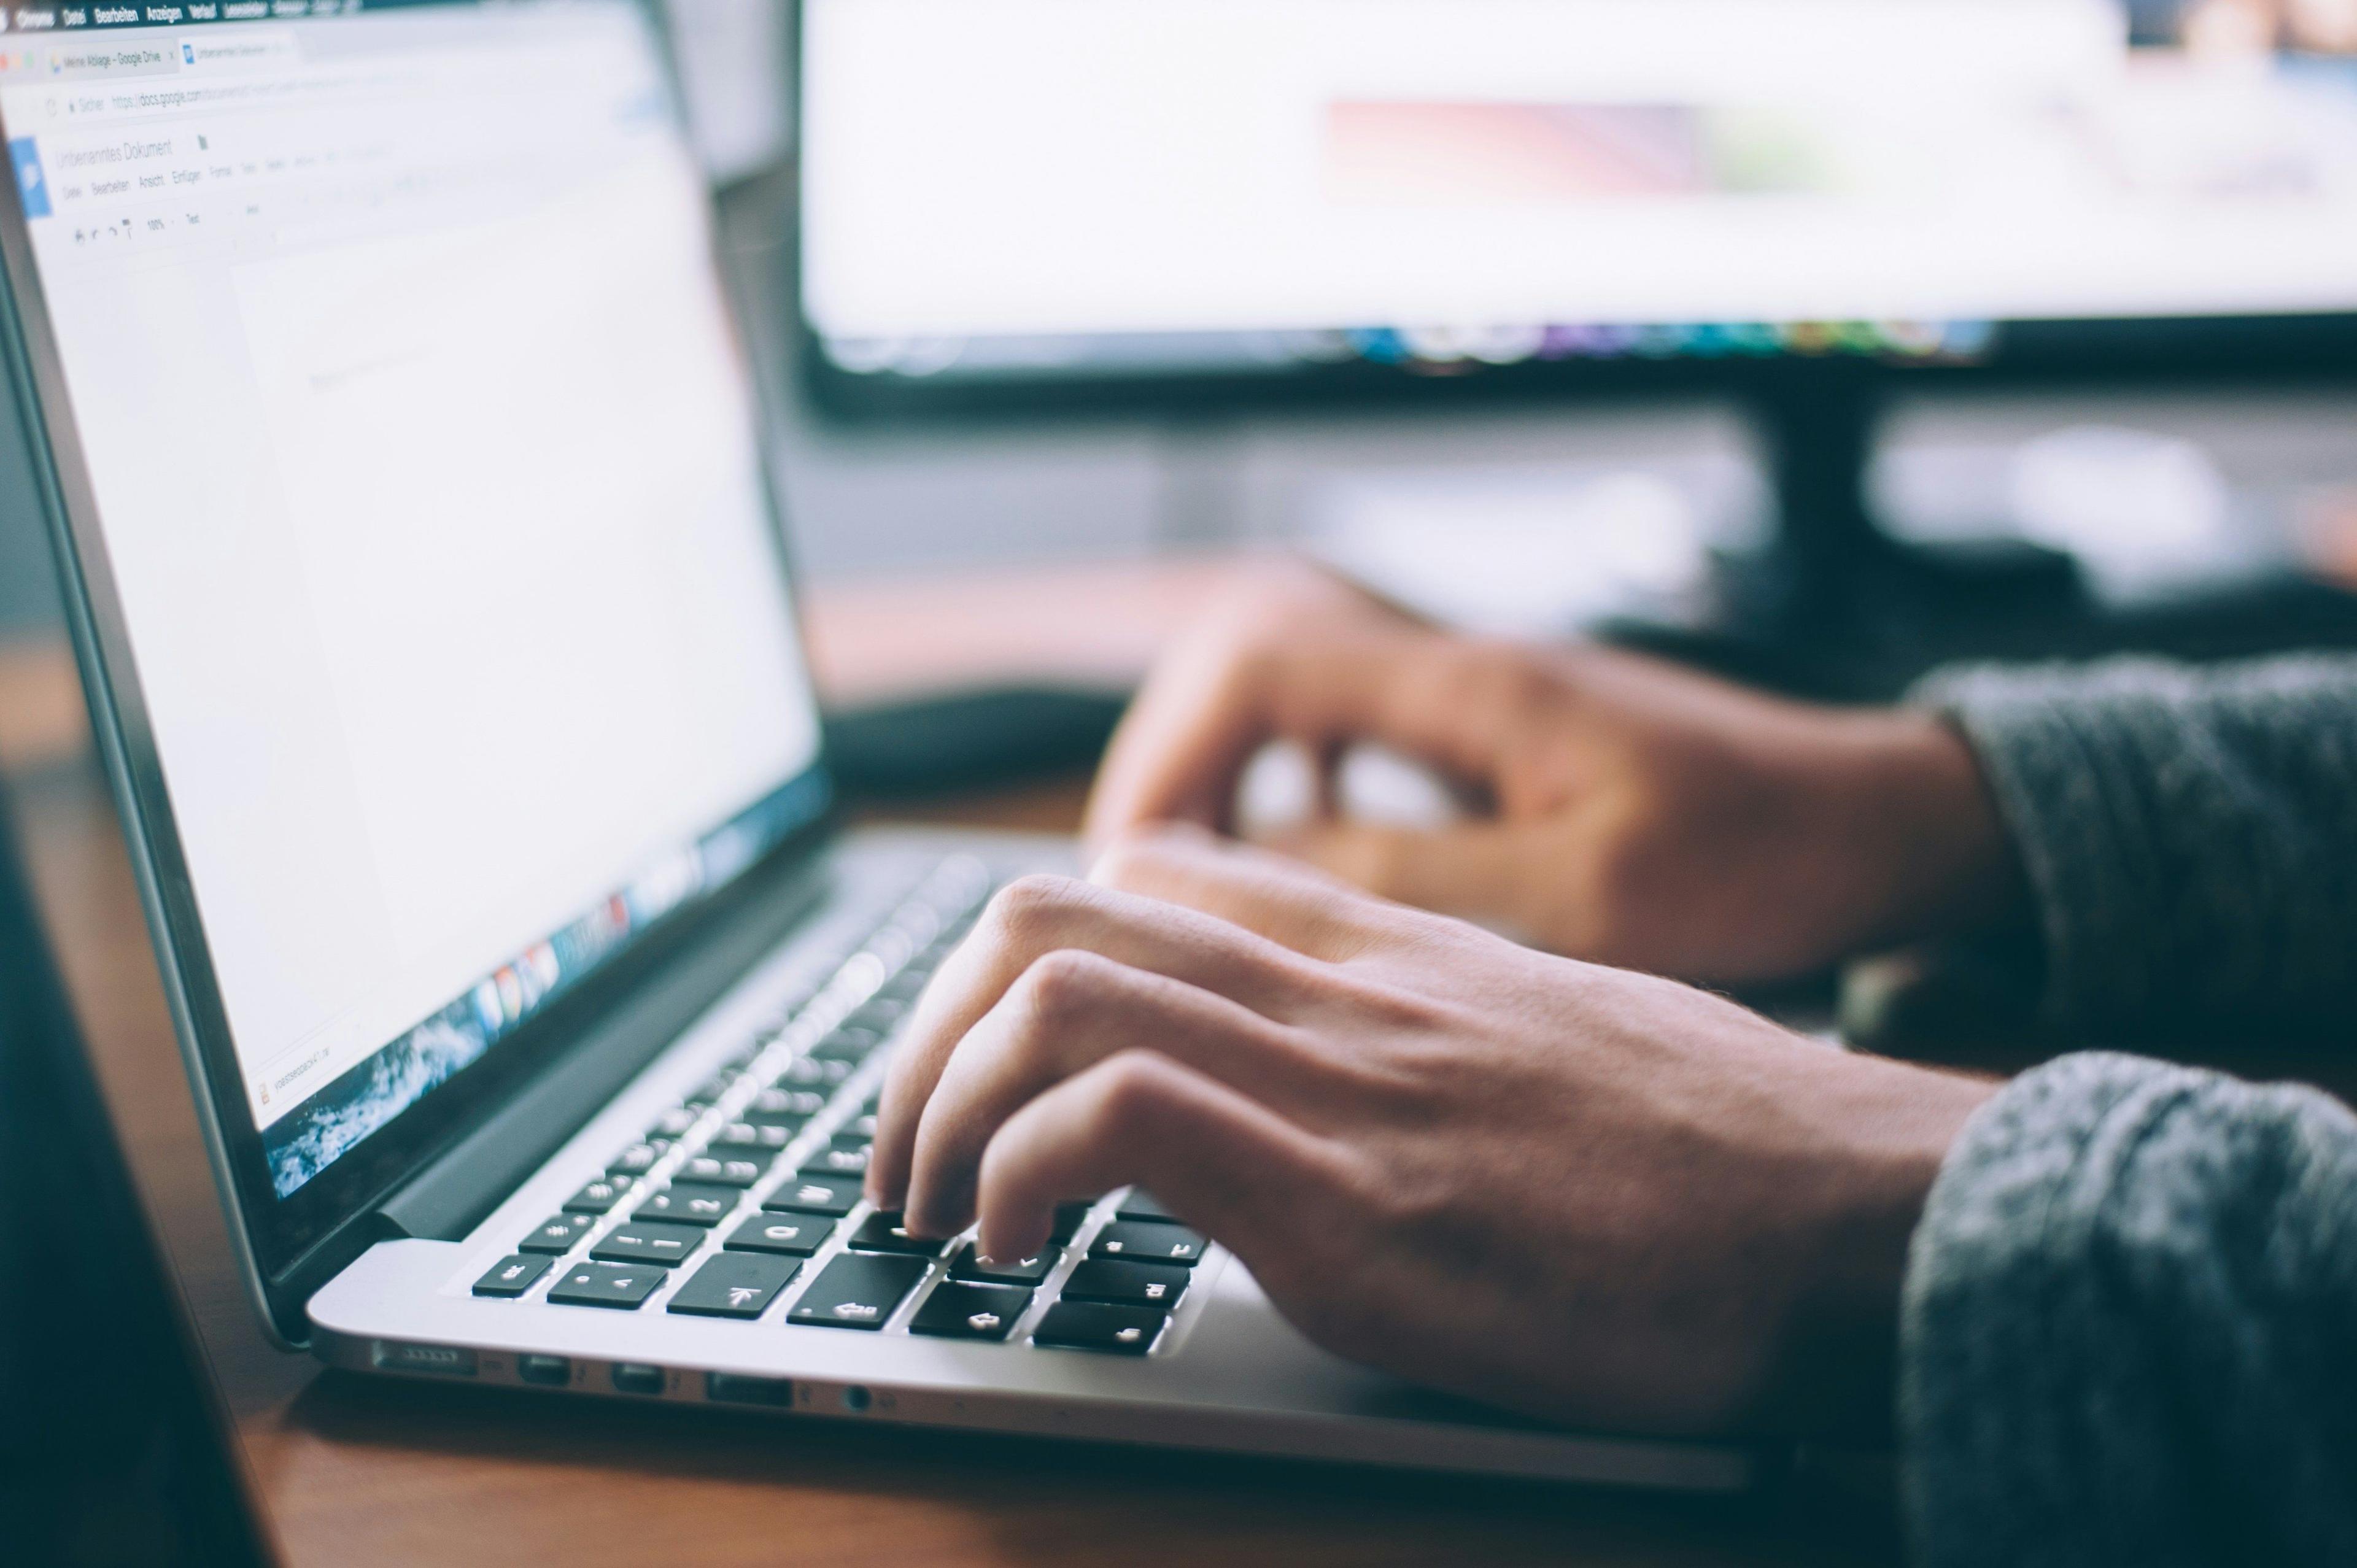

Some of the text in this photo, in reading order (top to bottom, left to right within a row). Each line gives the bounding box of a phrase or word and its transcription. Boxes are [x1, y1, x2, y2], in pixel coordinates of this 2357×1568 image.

[63, 9, 87, 26] Datei
[95, 7, 139, 24] Bearbeiten
[146, 6, 183, 23] Anzeigen
[87, 54, 112, 69] Ablage
[117, 51, 141, 66] Google
[142, 50, 161, 63] Drive
[79, 98, 104, 112] Sicher
[55, 138, 172, 169] Unbenanntes Dokument
[91, 180, 130, 196] Bearbeiten
[139, 174, 165, 188] Ansicht
[147, 218, 164, 231] 100%
[764, 1225, 799, 1240] Q
